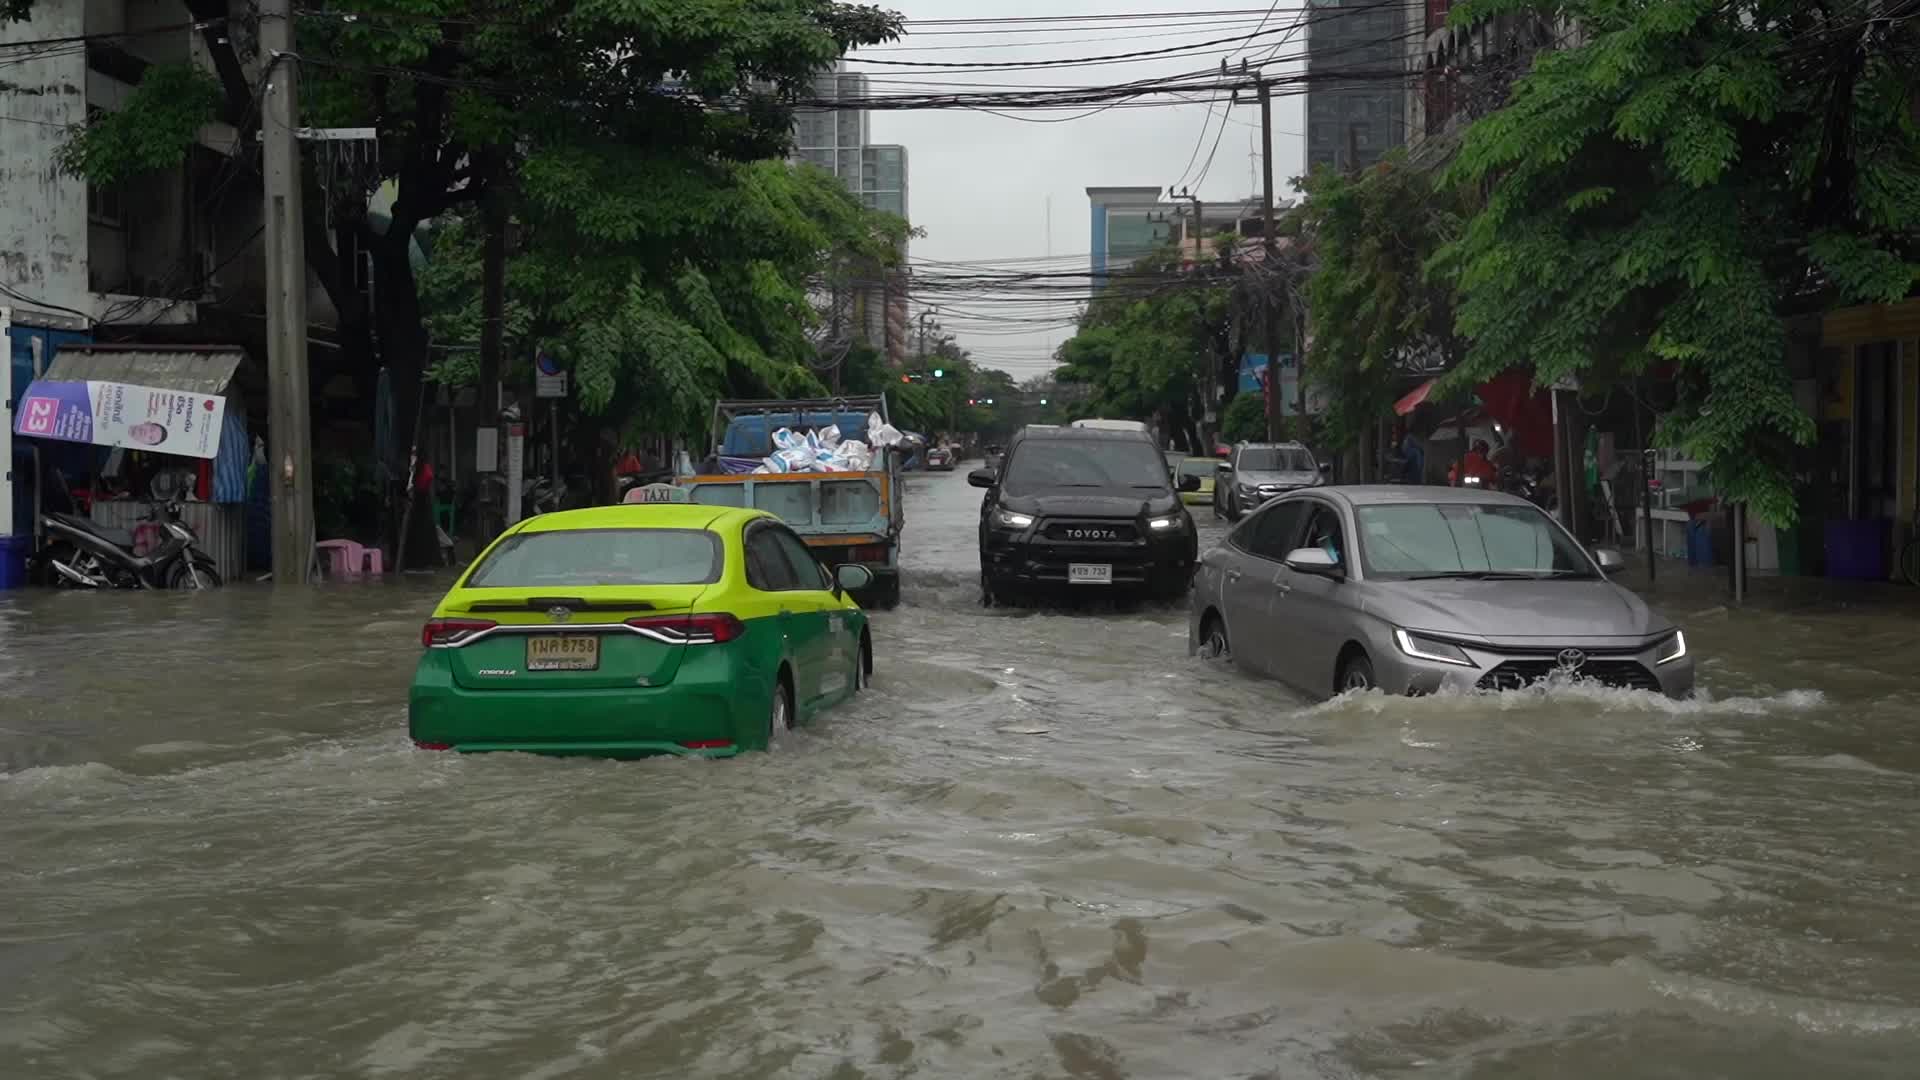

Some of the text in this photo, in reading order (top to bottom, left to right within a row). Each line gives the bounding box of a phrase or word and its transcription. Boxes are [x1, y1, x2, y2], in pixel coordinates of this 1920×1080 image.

[29, 401, 49, 431] 23
[642, 488, 670, 502] TAXI
[1066, 529, 1117, 539] TOYOTA
